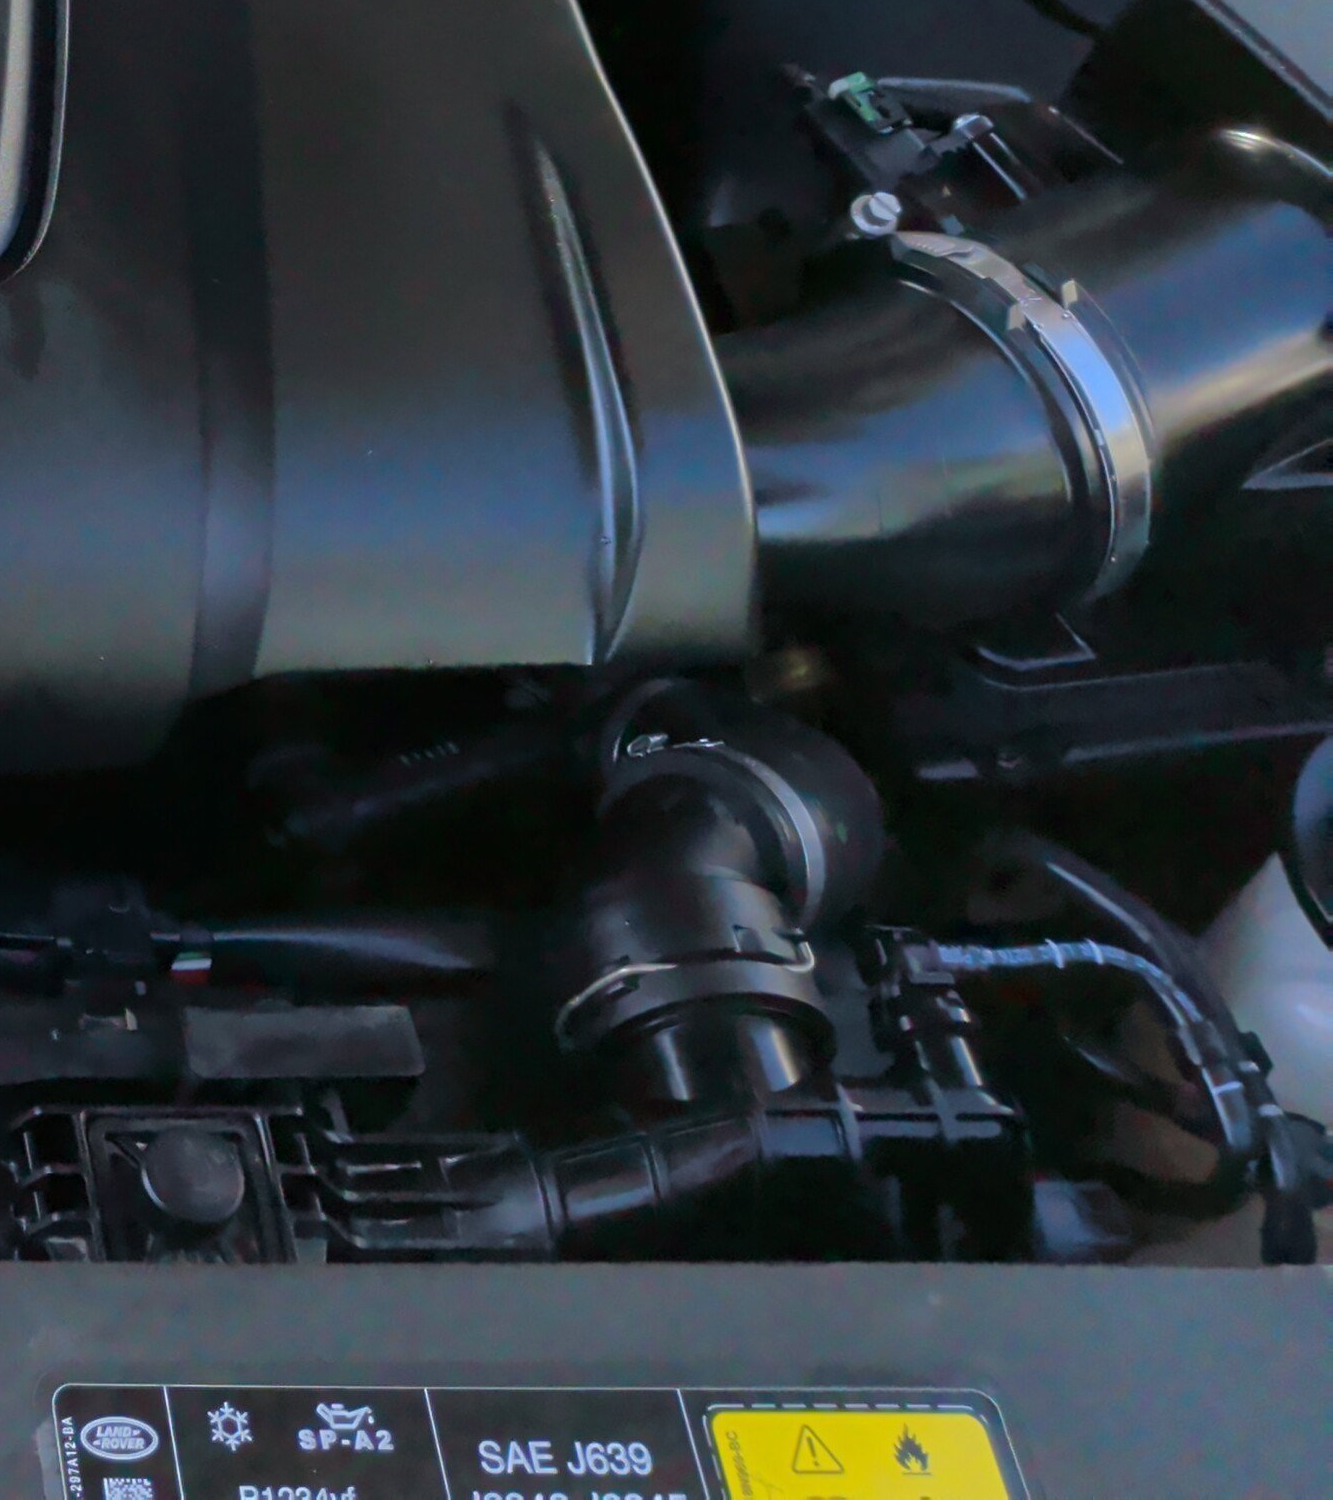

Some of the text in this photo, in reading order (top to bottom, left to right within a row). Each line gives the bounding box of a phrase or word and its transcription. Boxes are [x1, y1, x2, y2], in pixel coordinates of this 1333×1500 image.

[297, 1429, 395, 1451] SP-A2
[478, 1440, 653, 1476] SAE J639
